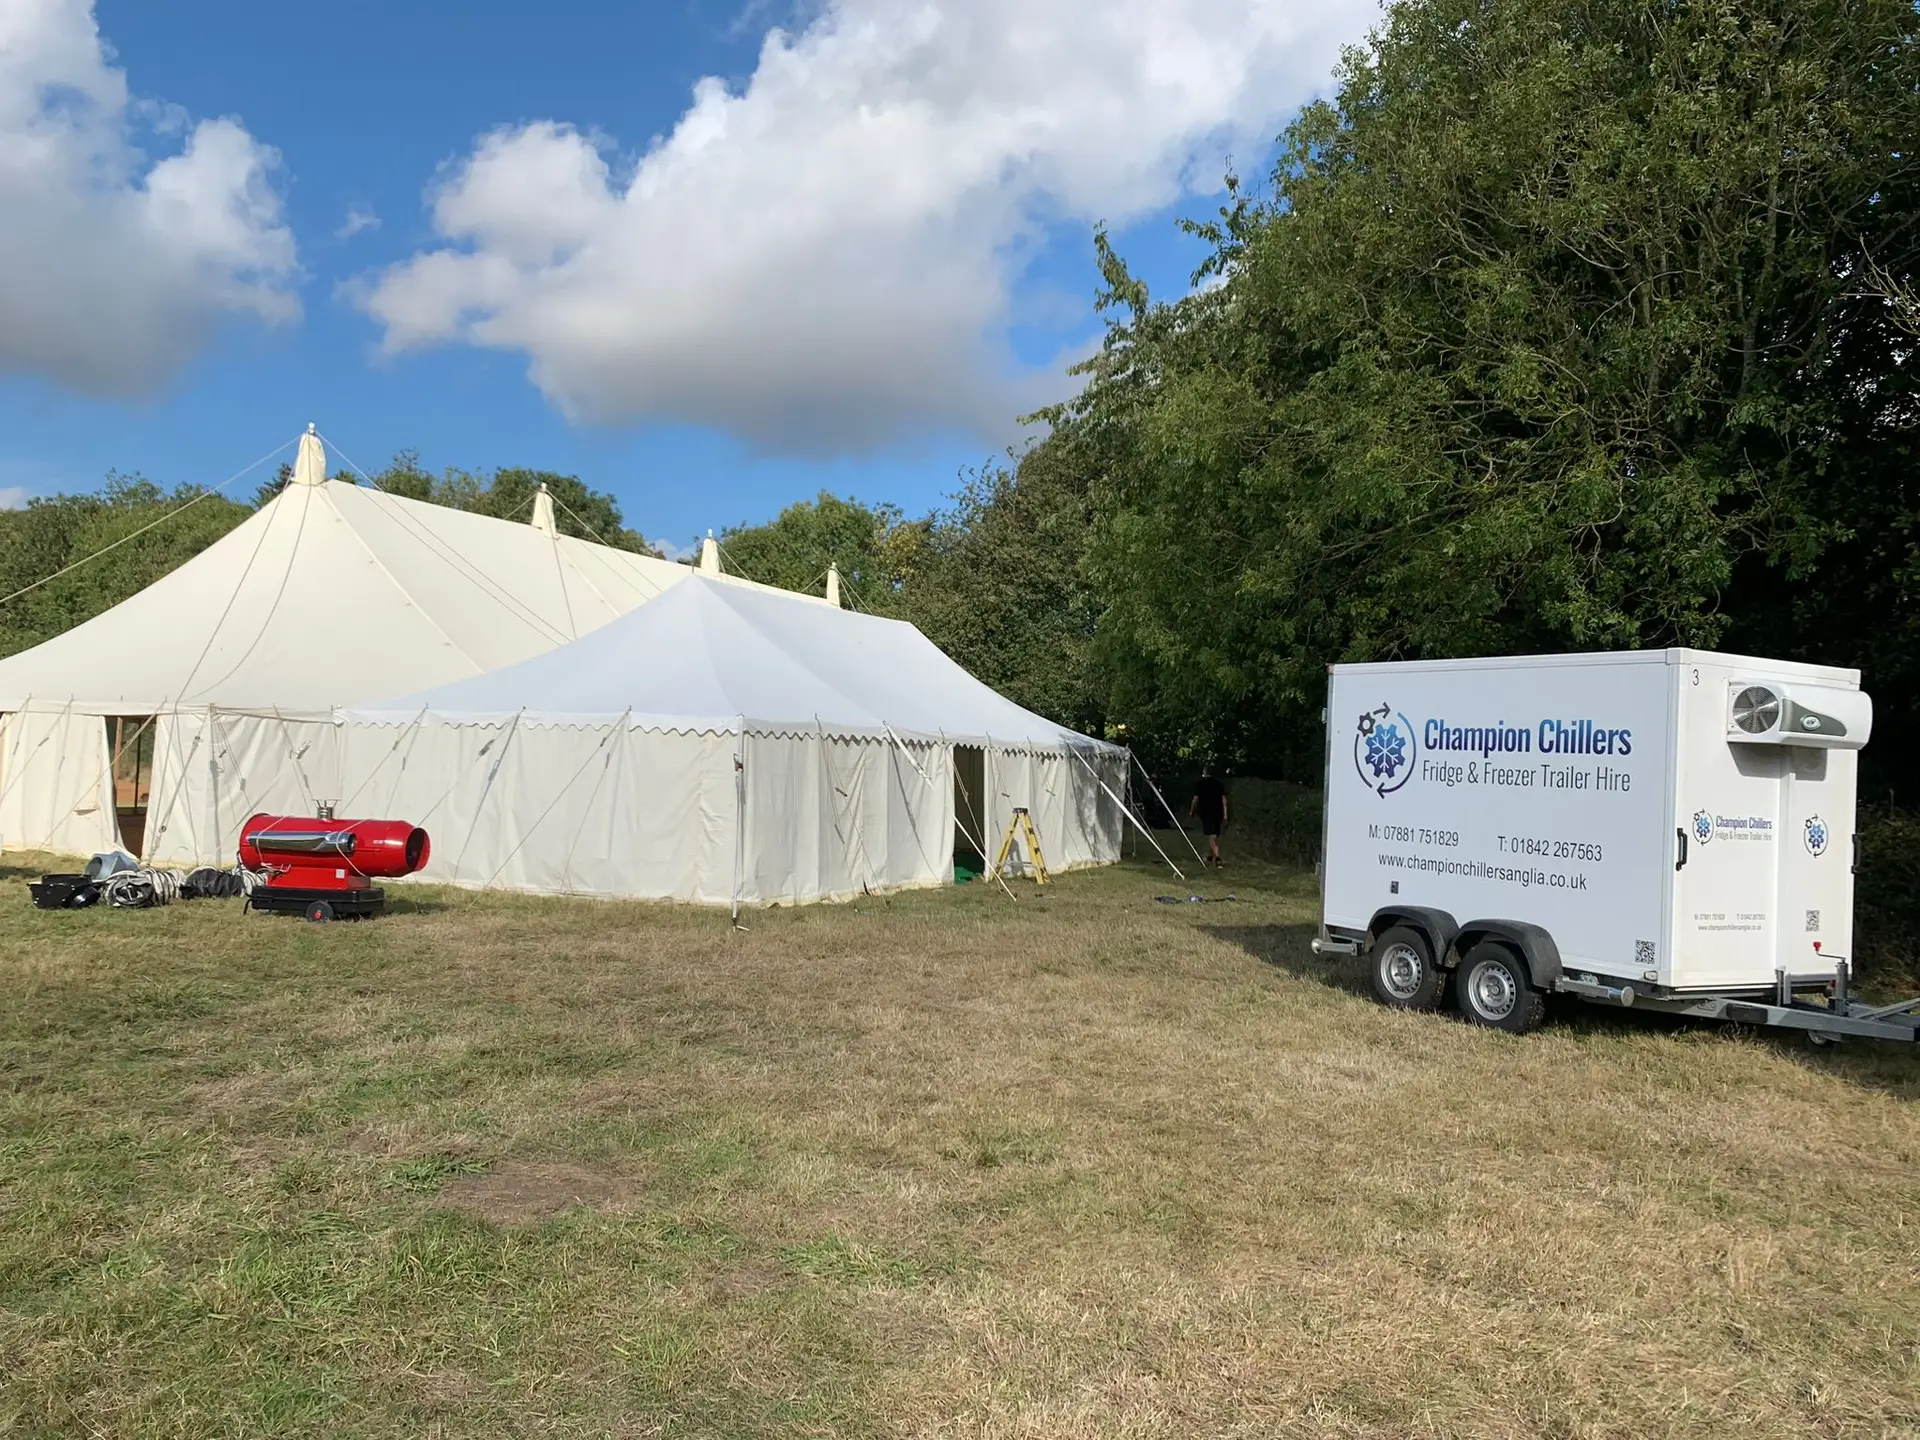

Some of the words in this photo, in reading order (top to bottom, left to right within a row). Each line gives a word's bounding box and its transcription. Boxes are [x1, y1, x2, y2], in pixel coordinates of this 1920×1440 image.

[1692, 669, 1700, 686] 3
[1424, 718, 1531, 760] Champion
[1538, 718, 1633, 756] Chillers
[1422, 759, 1463, 788] Fridge
[1467, 761, 1479, 785] &
[1483, 761, 1537, 787] Freezer
[1540, 763, 1592, 790] Trailer
[1595, 766, 1631, 792] Hire
[1368, 823, 1381, 839] M:
[1383, 825, 1415, 843] 07881
[1418, 828, 1459, 847] 751829
[1716, 815, 1748, 831] Champion
[1749, 816, 1772, 830] Chillers
[1497, 835, 1508, 852] T:
[1510, 836, 1550, 857] 01842
[1553, 840, 1603, 862] 267563
[1378, 854, 1587, 891] www.championchillersanglia.co.uk
